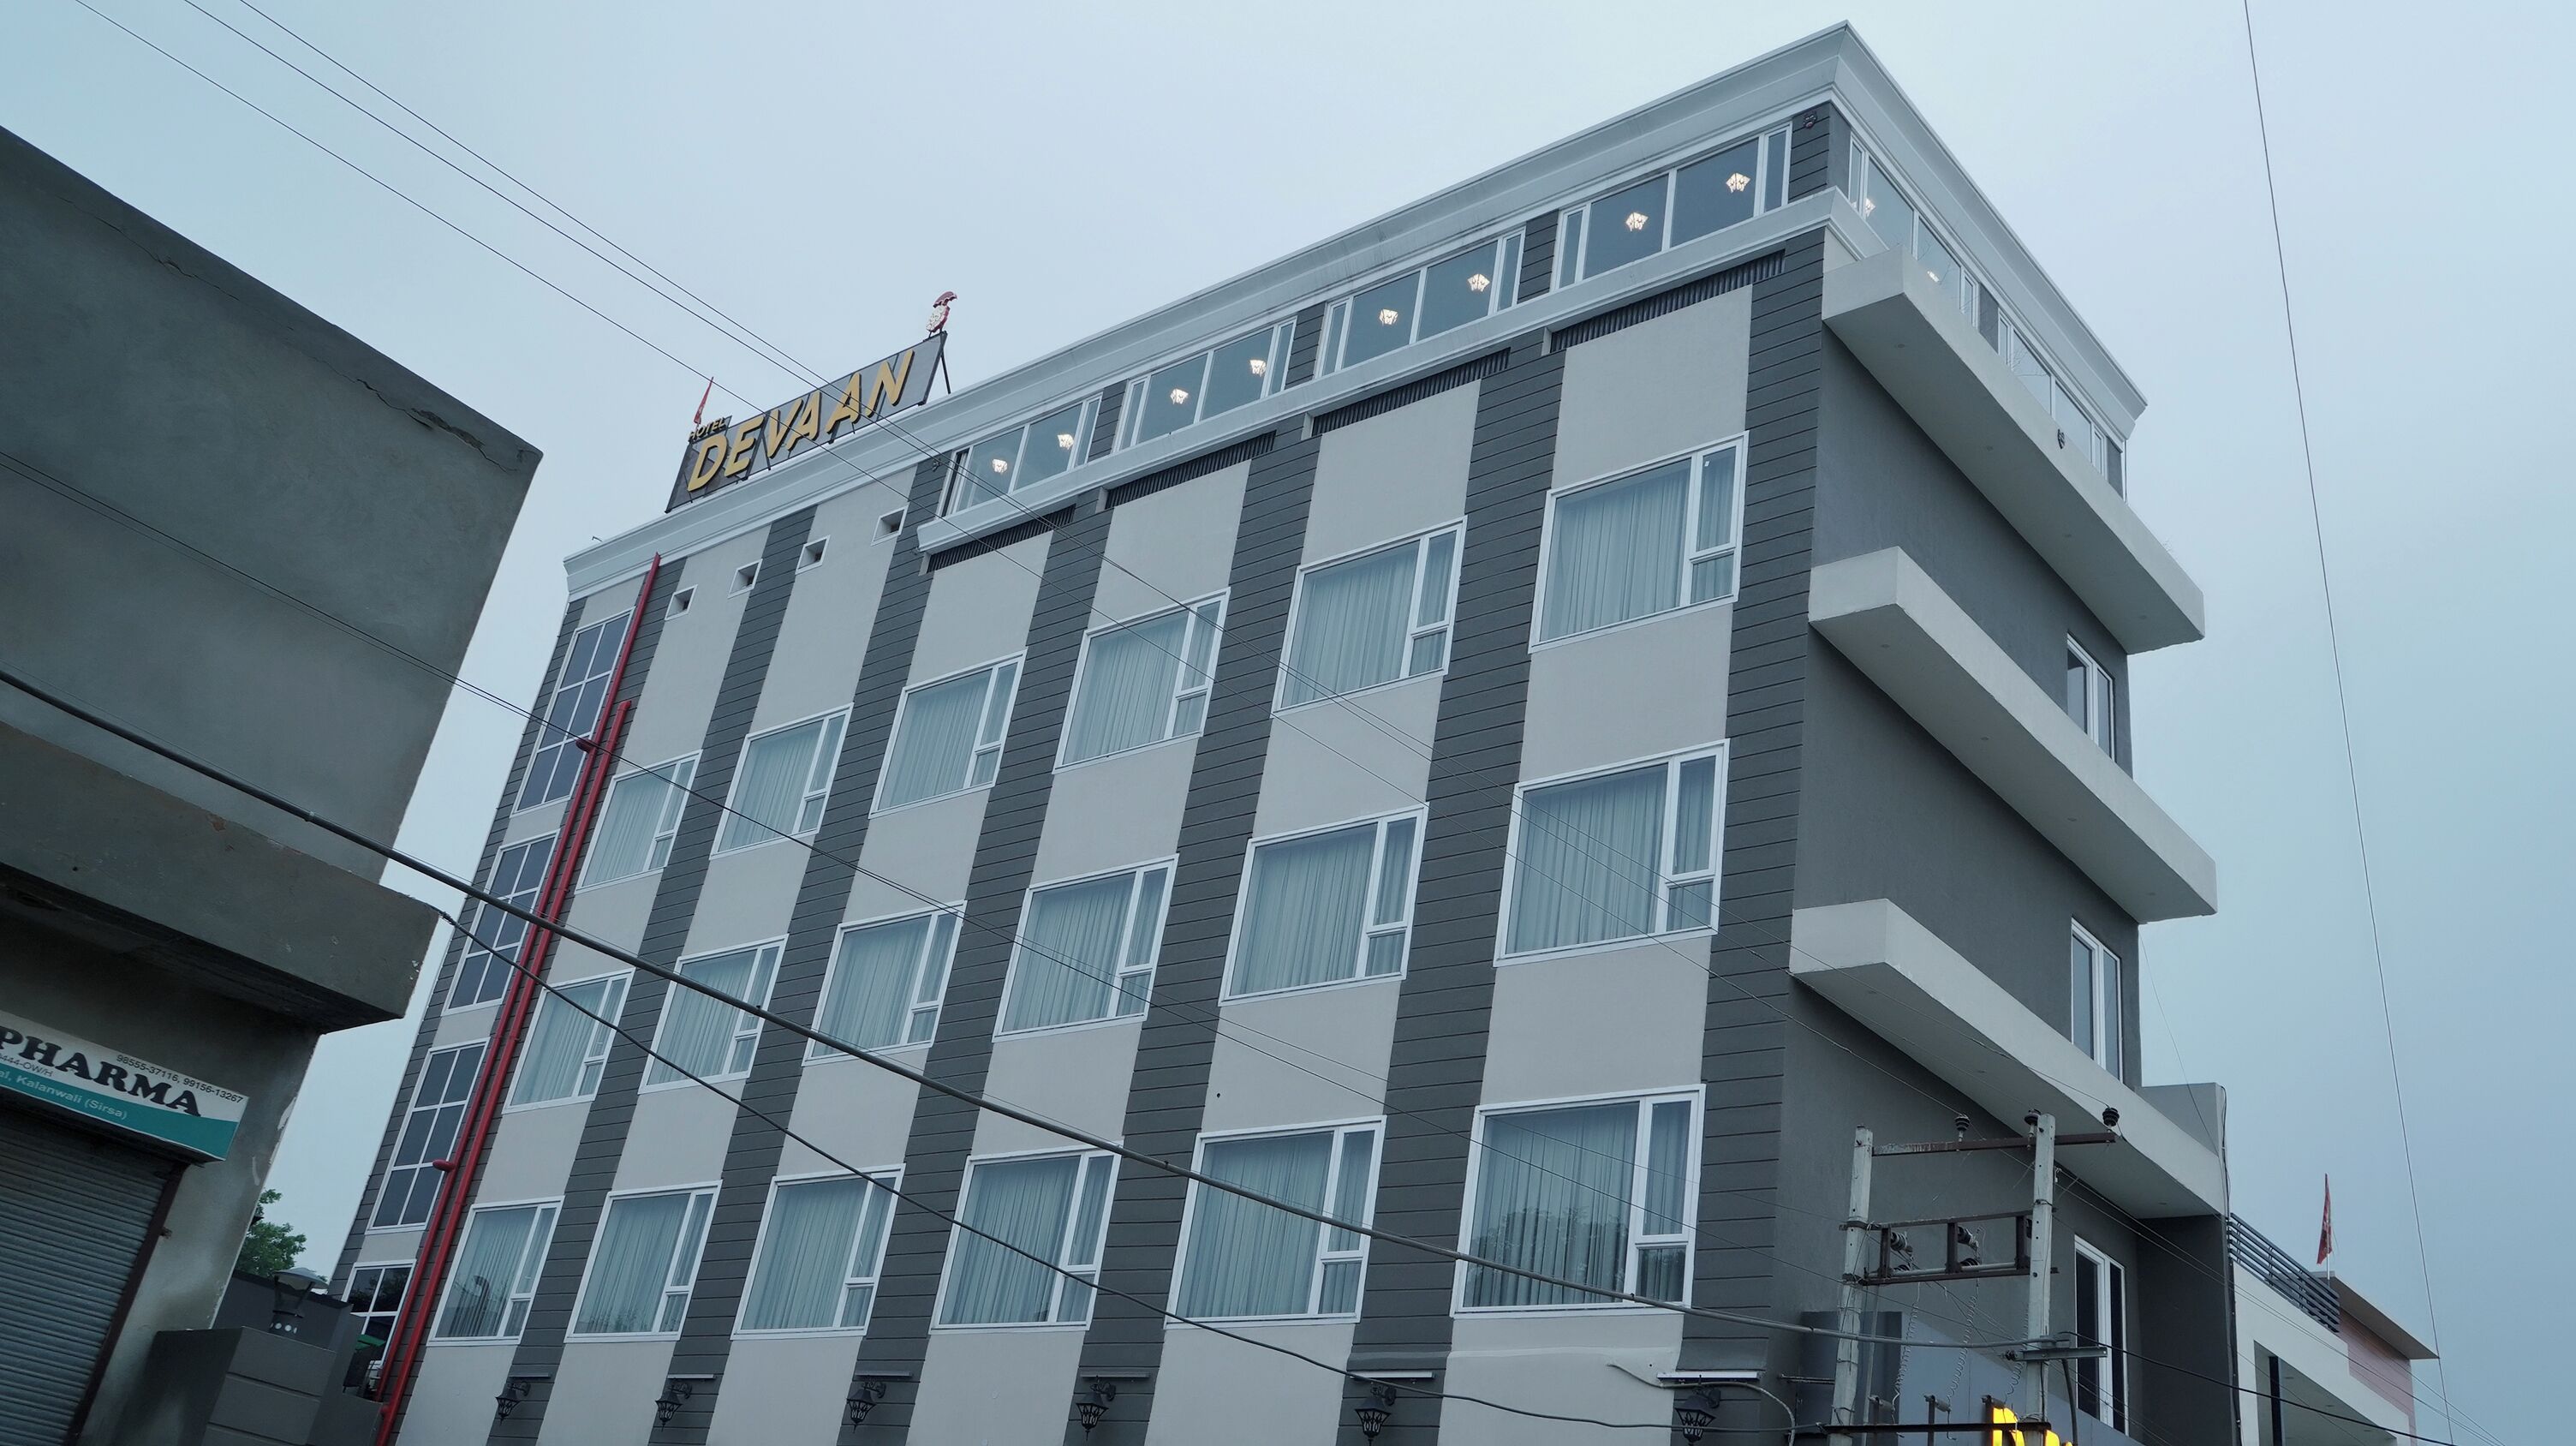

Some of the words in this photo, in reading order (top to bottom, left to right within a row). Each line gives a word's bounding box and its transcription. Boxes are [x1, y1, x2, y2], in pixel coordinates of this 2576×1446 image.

[687, 349, 915, 493] DEVAAN
[689, 417, 726, 441] HOTEL
[0, 1025, 201, 1117] PHARMA
[17, 1075, 83, 1104] Kalanwali
[84, 1097, 128, 1120] (Sirsa)
